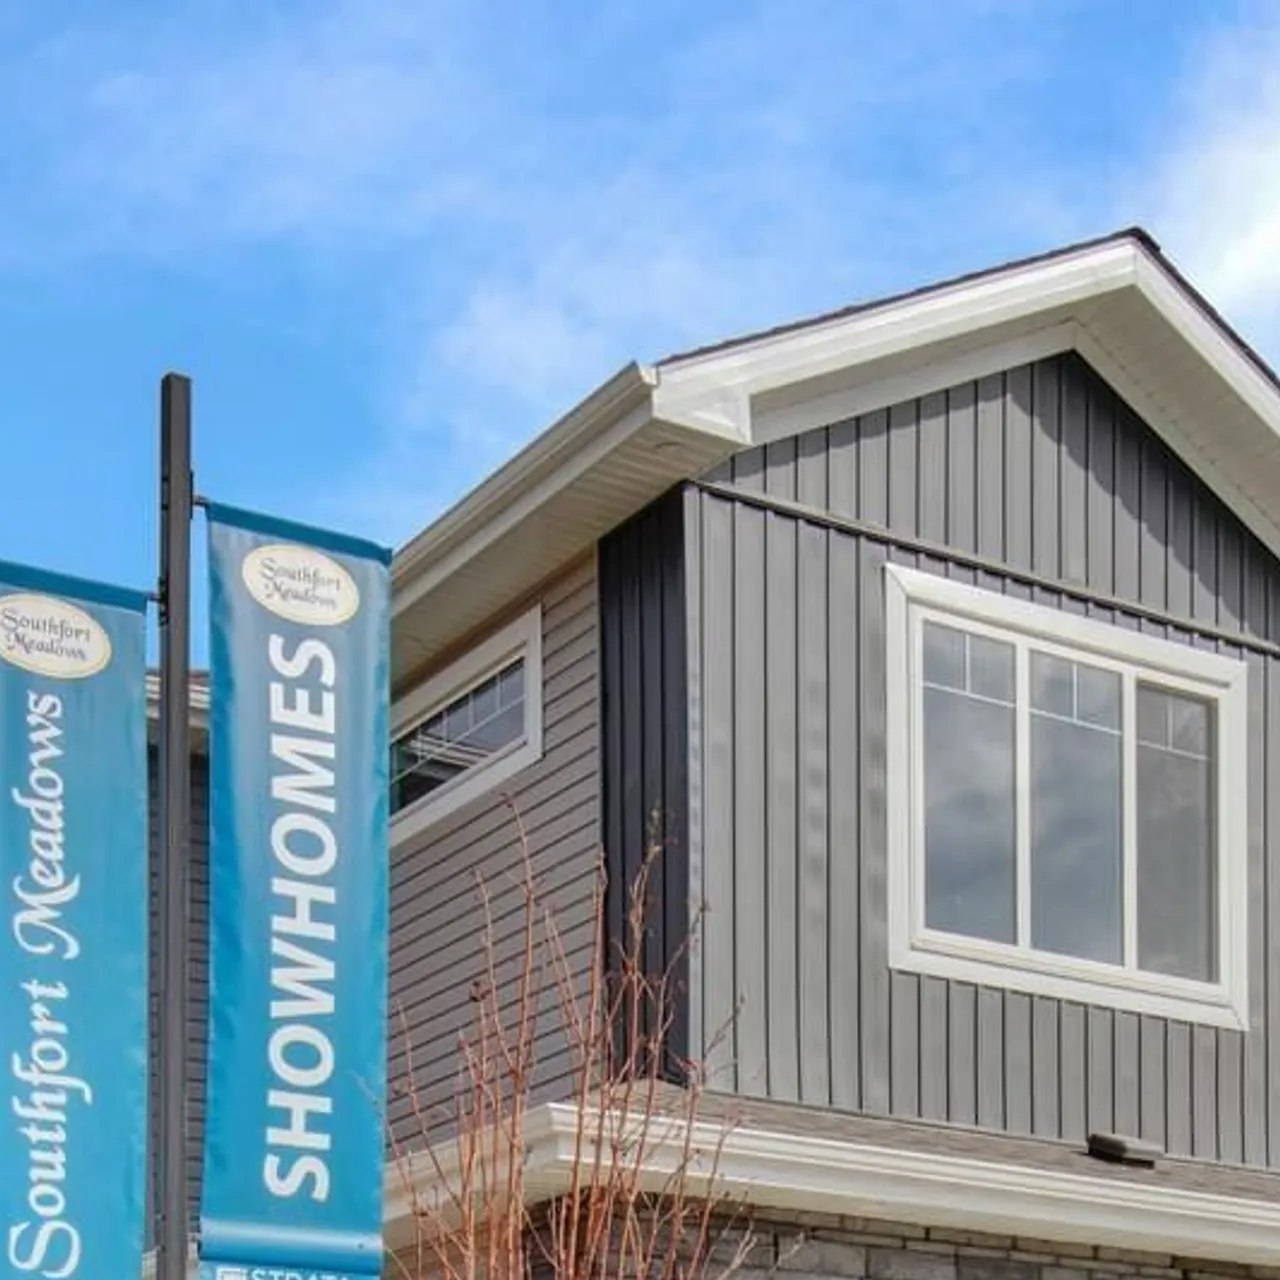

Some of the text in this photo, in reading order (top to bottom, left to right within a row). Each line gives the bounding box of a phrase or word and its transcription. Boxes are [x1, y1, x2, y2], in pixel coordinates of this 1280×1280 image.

[0, 608, 90, 643] Southfort
[5, 631, 87, 662] Meadows
[8, 691, 93, 1279] Southfort Meadows
[263, 633, 338, 1201] SHOWHOMES
